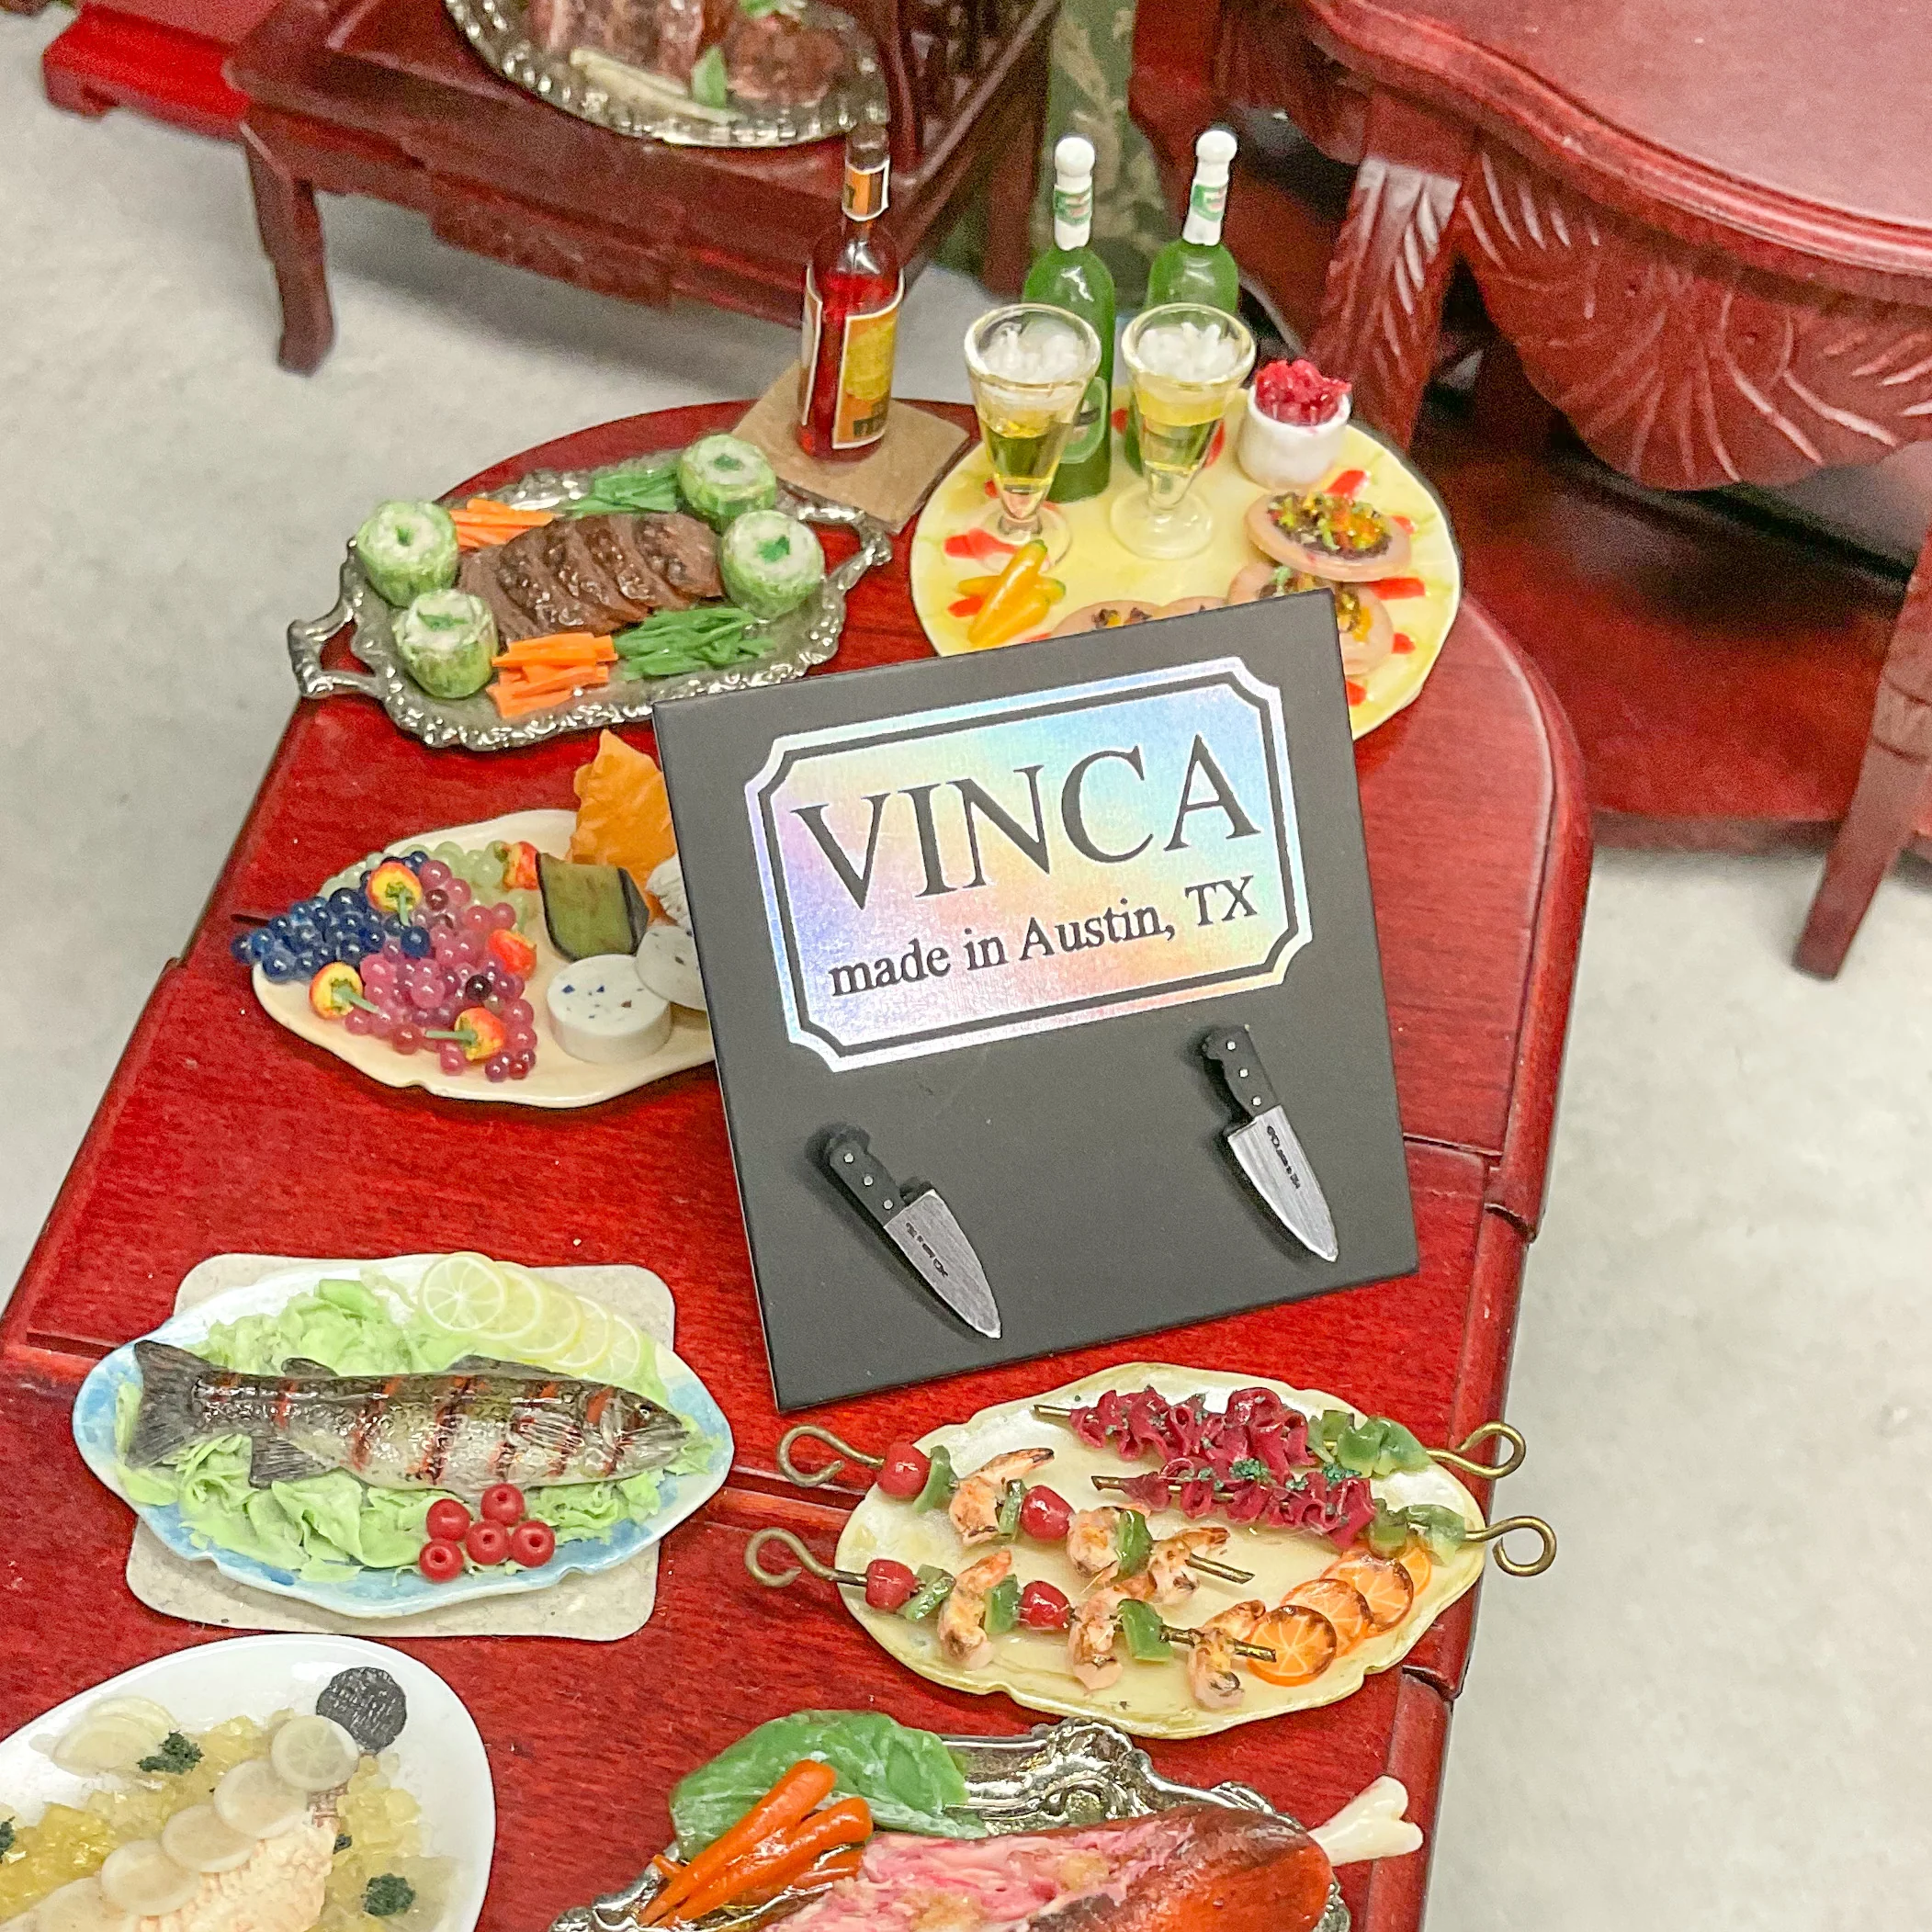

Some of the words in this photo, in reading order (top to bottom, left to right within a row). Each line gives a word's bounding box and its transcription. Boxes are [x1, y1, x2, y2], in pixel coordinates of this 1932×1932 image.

[790, 734, 1260, 910] VINCA
[829, 938, 951, 997] made
[964, 928, 1009, 971] in
[1019, 898, 1175, 961] Austin,
[1184, 875, 1258, 926] TX
